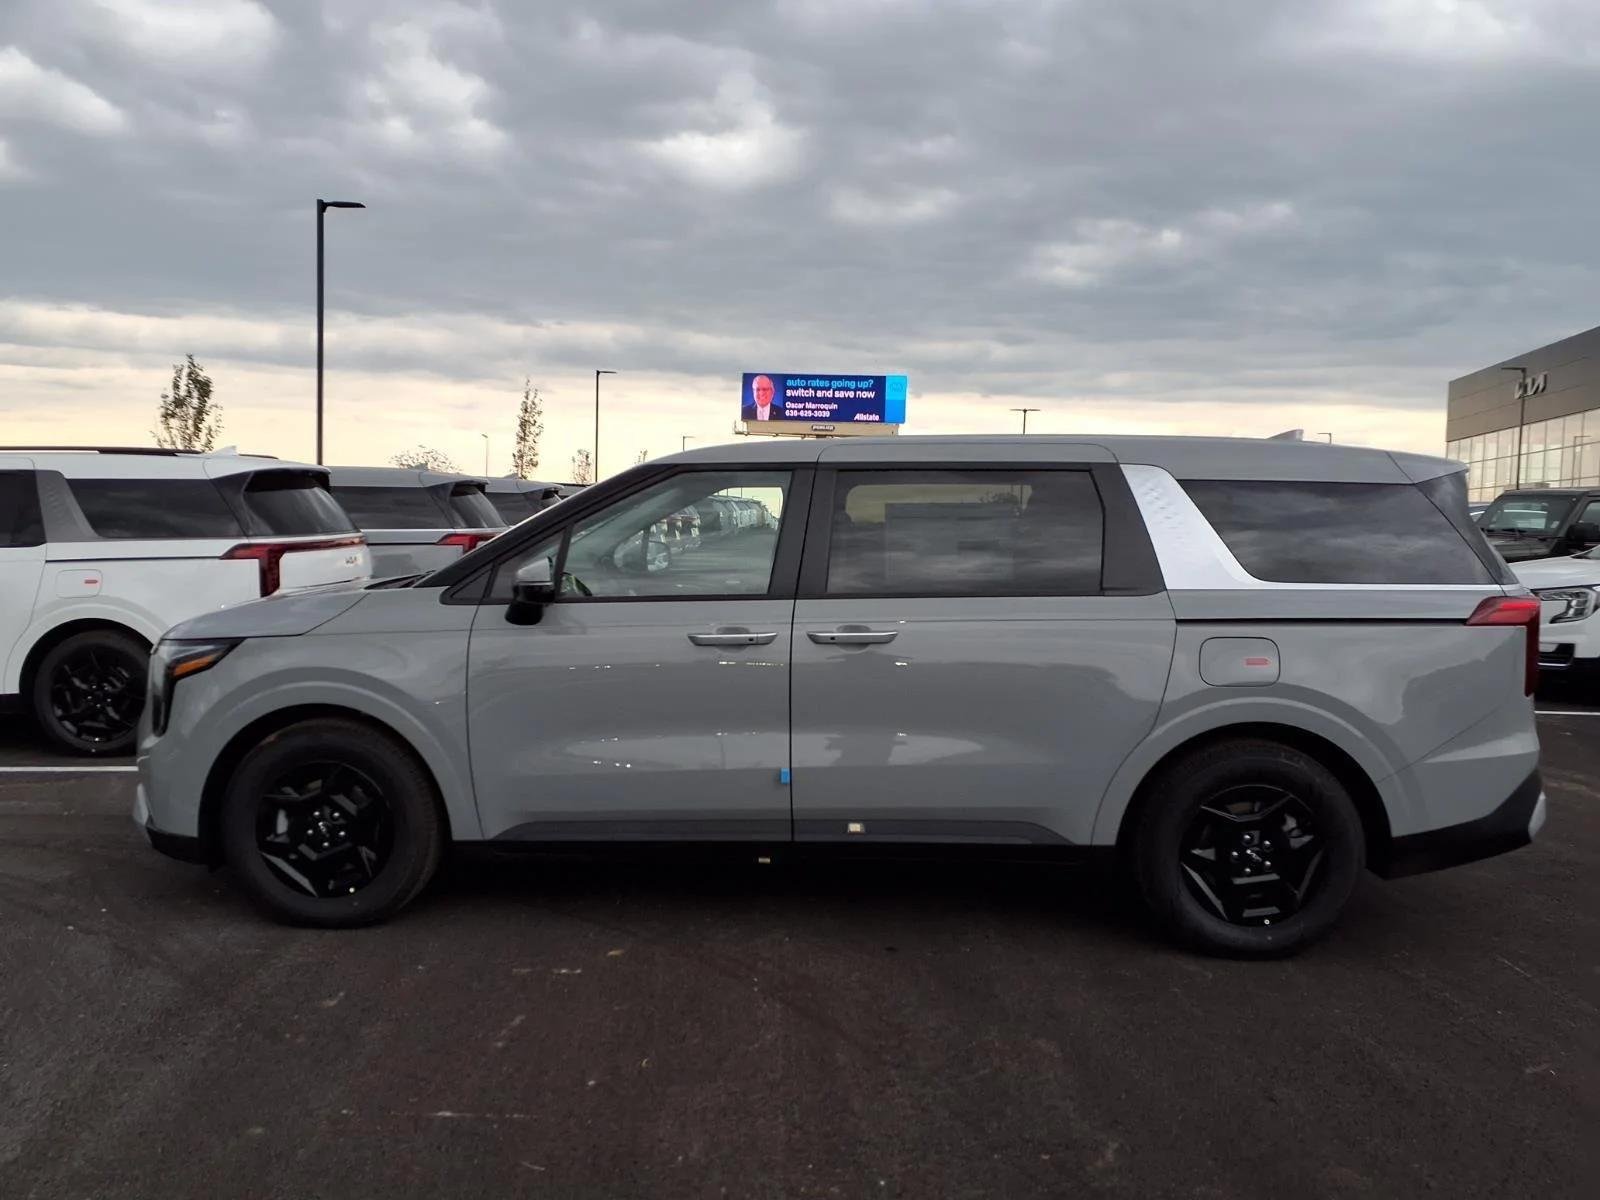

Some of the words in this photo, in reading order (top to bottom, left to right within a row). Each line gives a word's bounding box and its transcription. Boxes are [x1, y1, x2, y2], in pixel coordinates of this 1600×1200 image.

[786, 378, 806, 387] auto
[808, 378, 830, 387] rates
[831, 379, 856, 389] going
[857, 379, 874, 389] up?
[785, 388, 815, 398] switch
[816, 388, 833, 398] and
[834, 390, 855, 398] save
[856, 391, 875, 399] now
[805, 402, 838, 410] Marroquin
[854, 413, 880, 421] Allstate
